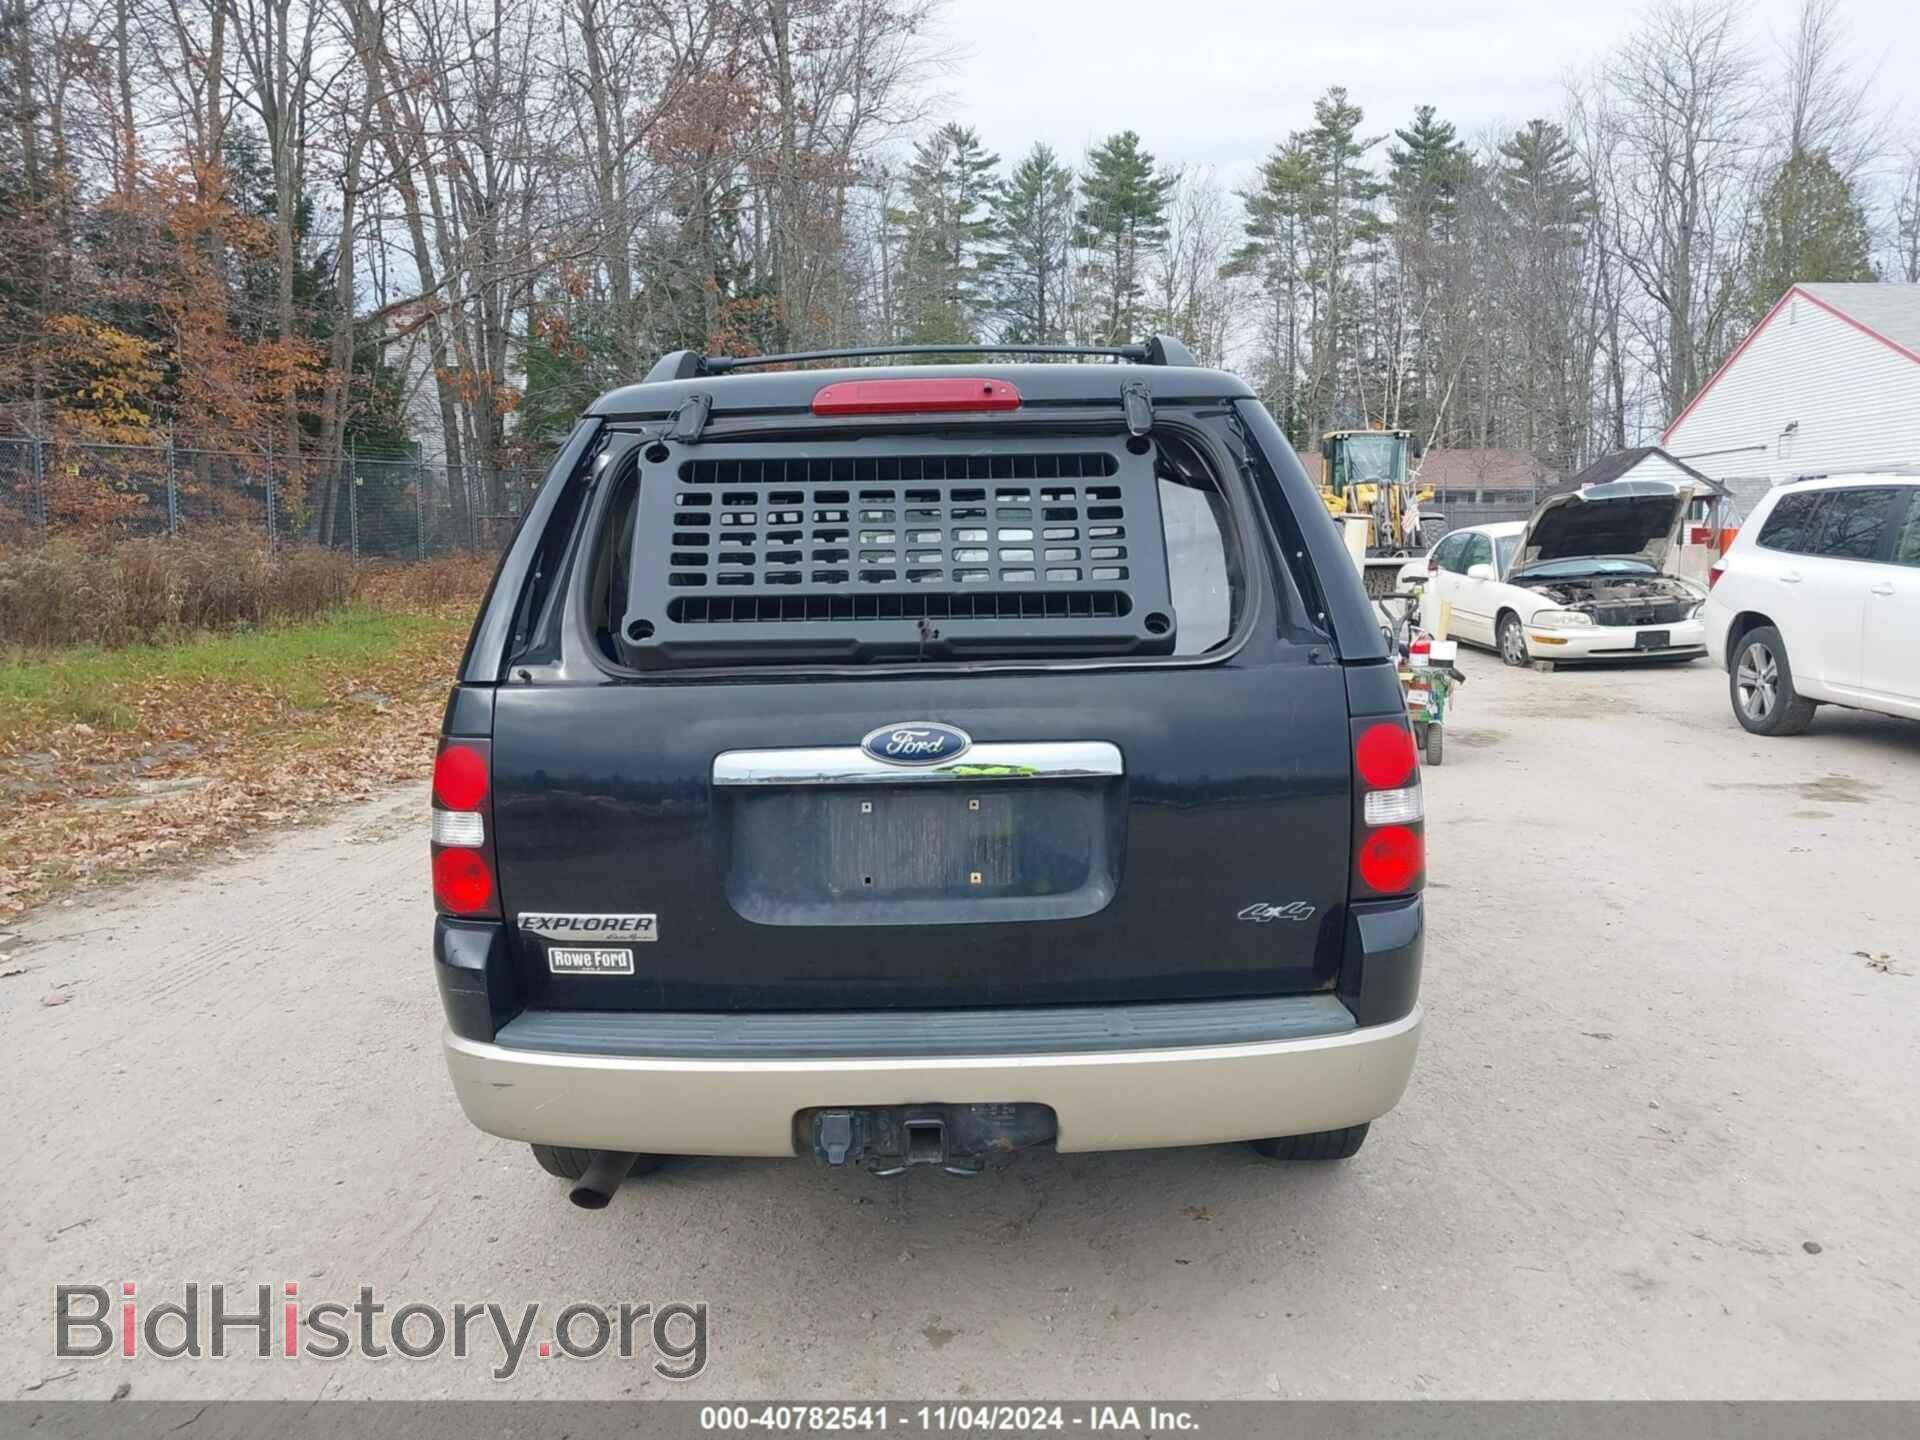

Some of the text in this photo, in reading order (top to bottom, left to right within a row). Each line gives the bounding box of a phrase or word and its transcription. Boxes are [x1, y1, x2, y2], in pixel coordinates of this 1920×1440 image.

[886, 730, 944, 755] Ford
[1237, 901, 1316, 922] 4x4
[523, 917, 653, 931] EXPLORER
[555, 951, 627, 967] Rowe Ford
